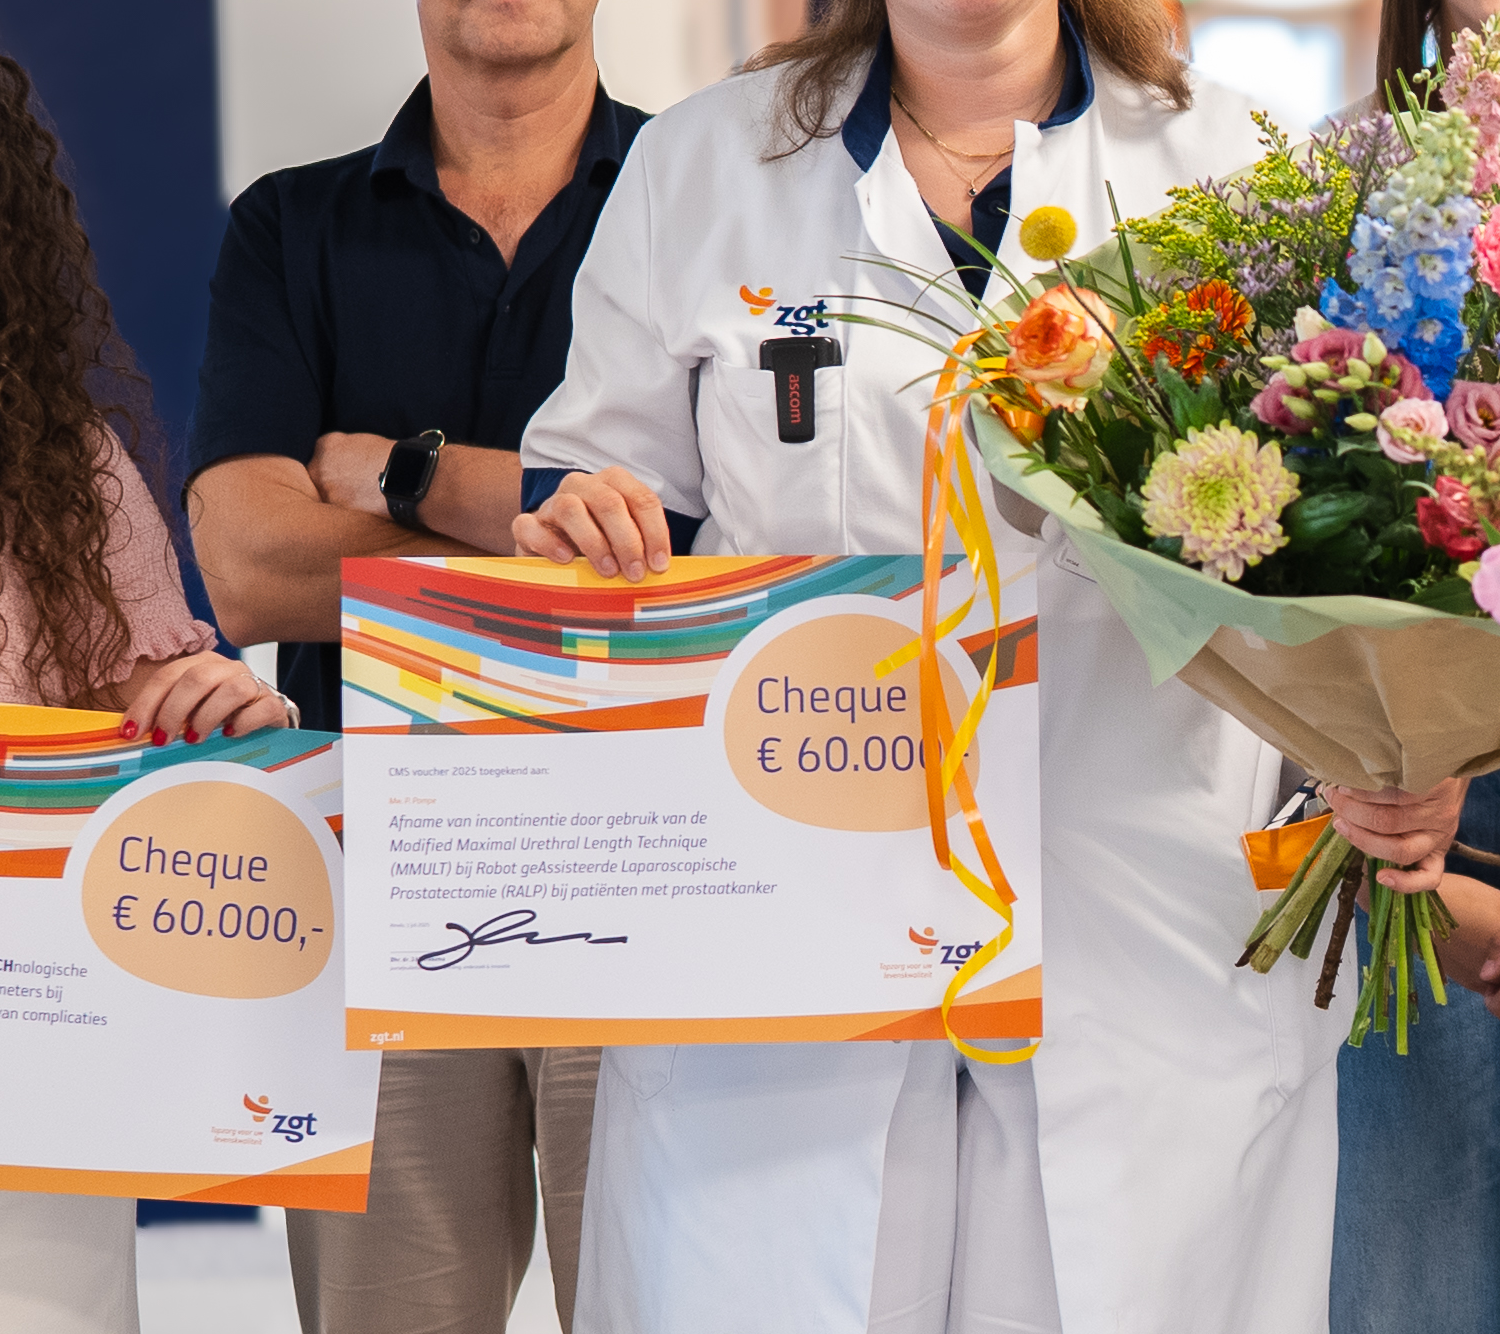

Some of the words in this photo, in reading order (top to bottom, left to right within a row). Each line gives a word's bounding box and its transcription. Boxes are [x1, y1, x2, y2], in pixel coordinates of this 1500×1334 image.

[774, 299, 829, 337] zgt
[789, 373, 801, 424] ascom
[758, 676, 907, 724] Cheque
[757, 737, 782, 773] €
[389, 767, 410, 776] CMS
[412, 767, 449, 776] voucher
[451, 767, 477, 776] 2025
[480, 766, 528, 777] toegekend
[389, 814, 443, 831] Afname
[447, 817, 471, 827] van
[475, 813, 567, 827] incontinentie
[571, 813, 603, 826] door
[606, 811, 658, 829] gebruik
[662, 814, 686, 825] van
[690, 811, 708, 824] de
[390, 838, 453, 855] Modified
[456, 837, 517, 851] Maximal
[520, 836, 579, 850] Urethral
[584, 835, 632, 852] Length
[638, 834, 708, 851] Technique
[119, 836, 268, 889] Cheque
[390, 861, 451, 877] (MMULT)
[455, 861, 473, 878] bij
[476, 861, 517, 875] Robot
[521, 860, 618, 877] geAssisteerde
[621, 857, 737, 875] Laparoscopische
[390, 885, 497, 899] Prostatectomie
[501, 883, 547, 899] (RALP)
[551, 884, 568, 901] bij
[570, 882, 638, 900] patiënten
[641, 884, 668, 896] met
[671, 881, 778, 899] prostaatkanker
[112, 895, 139, 931] €
[153, 898, 323, 952] 60.000,-
[46, 985, 63, 1003] bij
[22, 1009, 108, 1026] complicaties
[370, 1030, 404, 1045] zgt.nl
[271, 1113, 318, 1143] zgt
